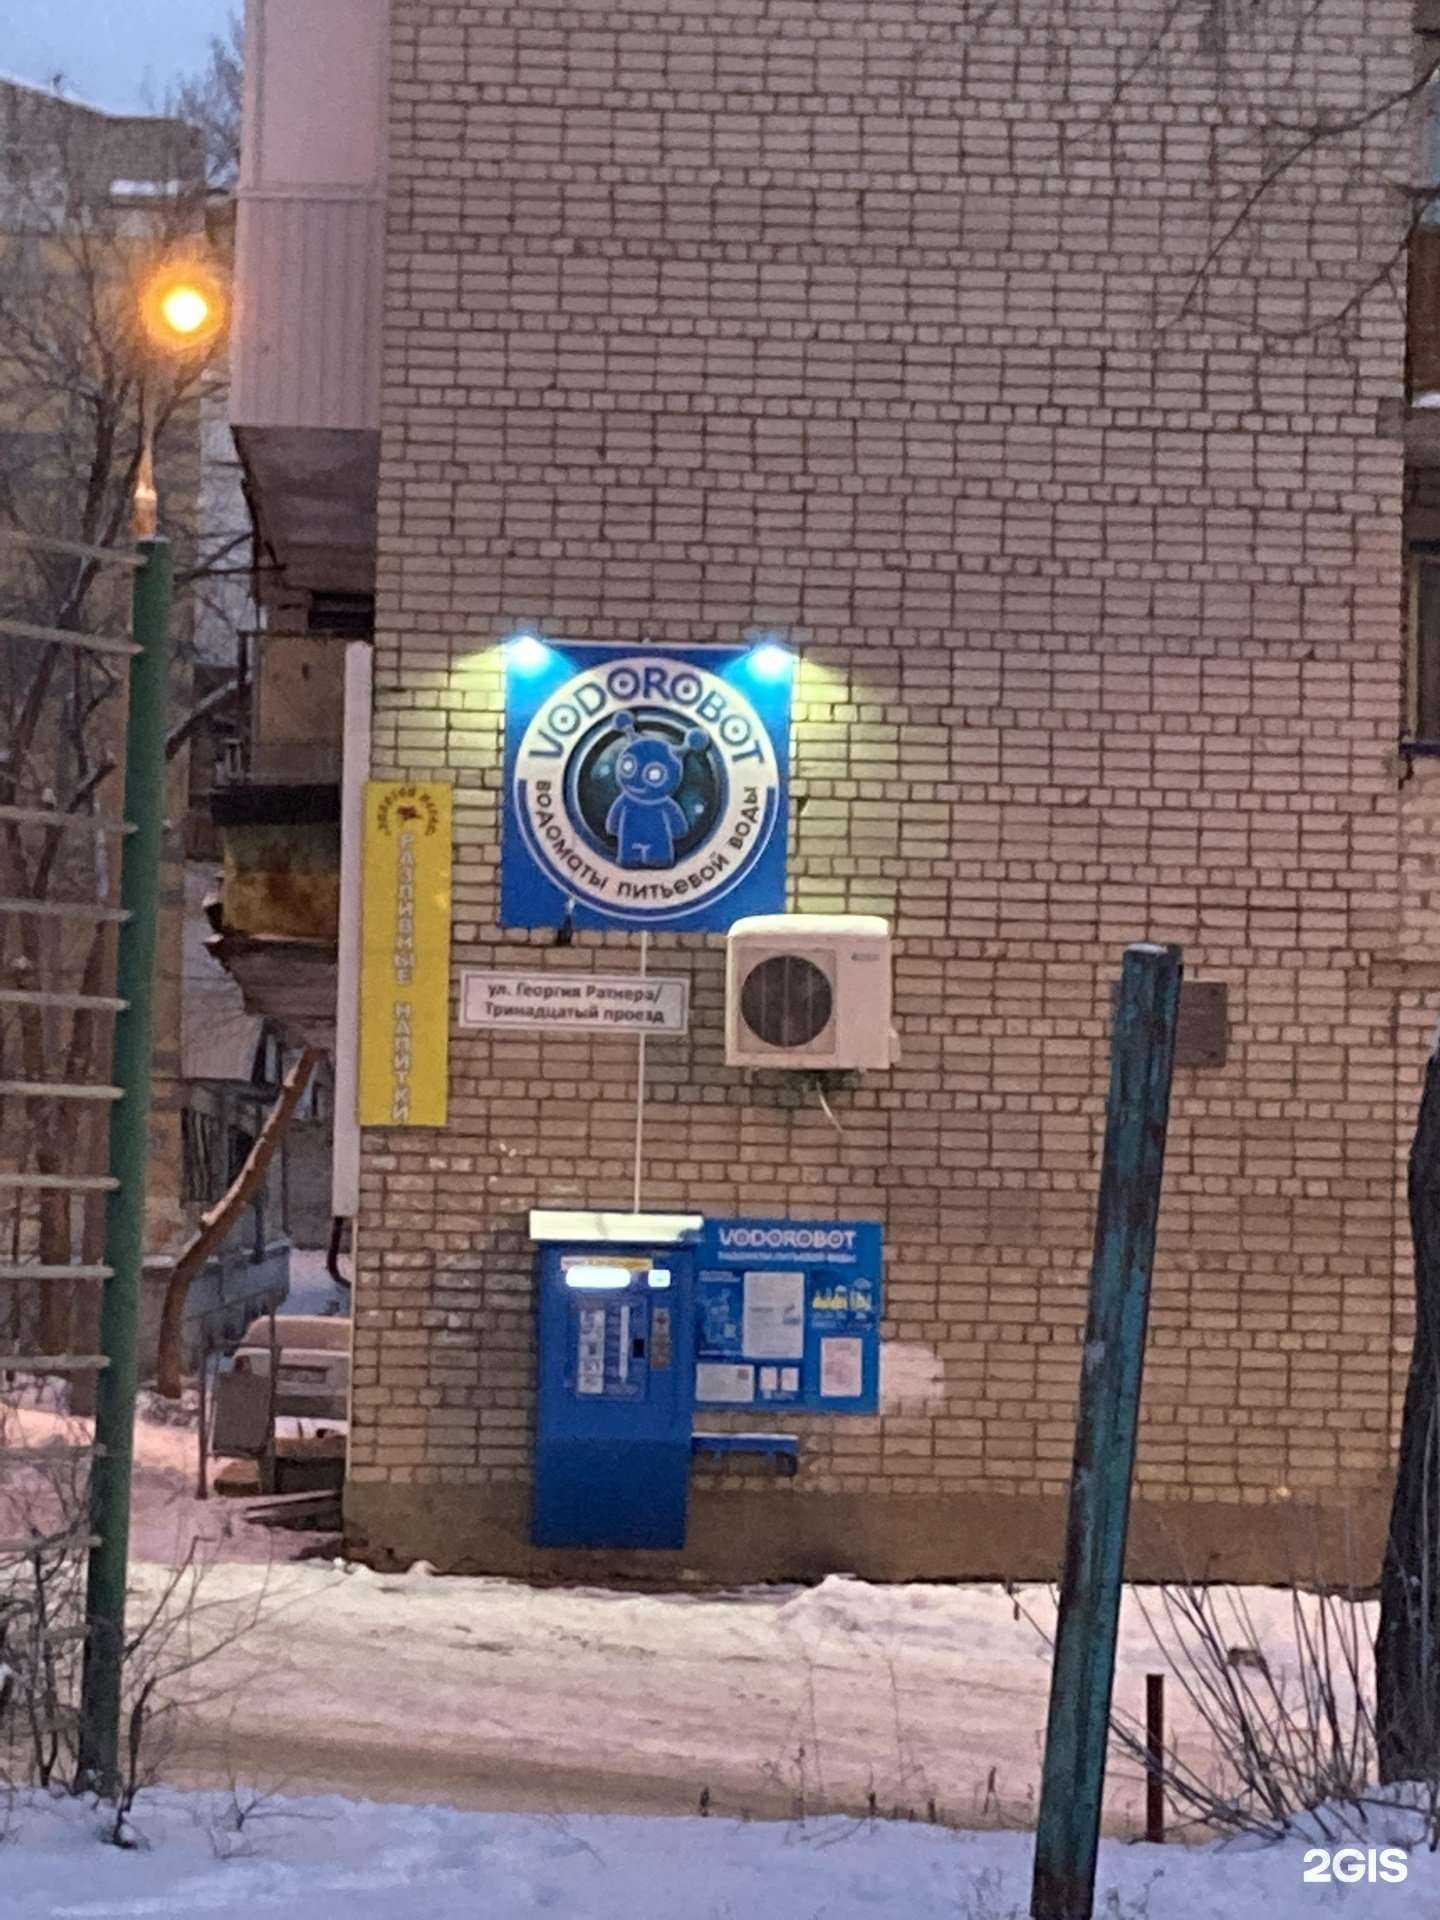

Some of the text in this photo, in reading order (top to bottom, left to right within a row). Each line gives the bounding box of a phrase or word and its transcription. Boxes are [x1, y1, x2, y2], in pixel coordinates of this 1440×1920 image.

[528, 667, 764, 764] VODOROBOT
[486, 1001, 666, 1024] Тринадцатый проезд
[719, 1228, 857, 1249] VODOROBOT
